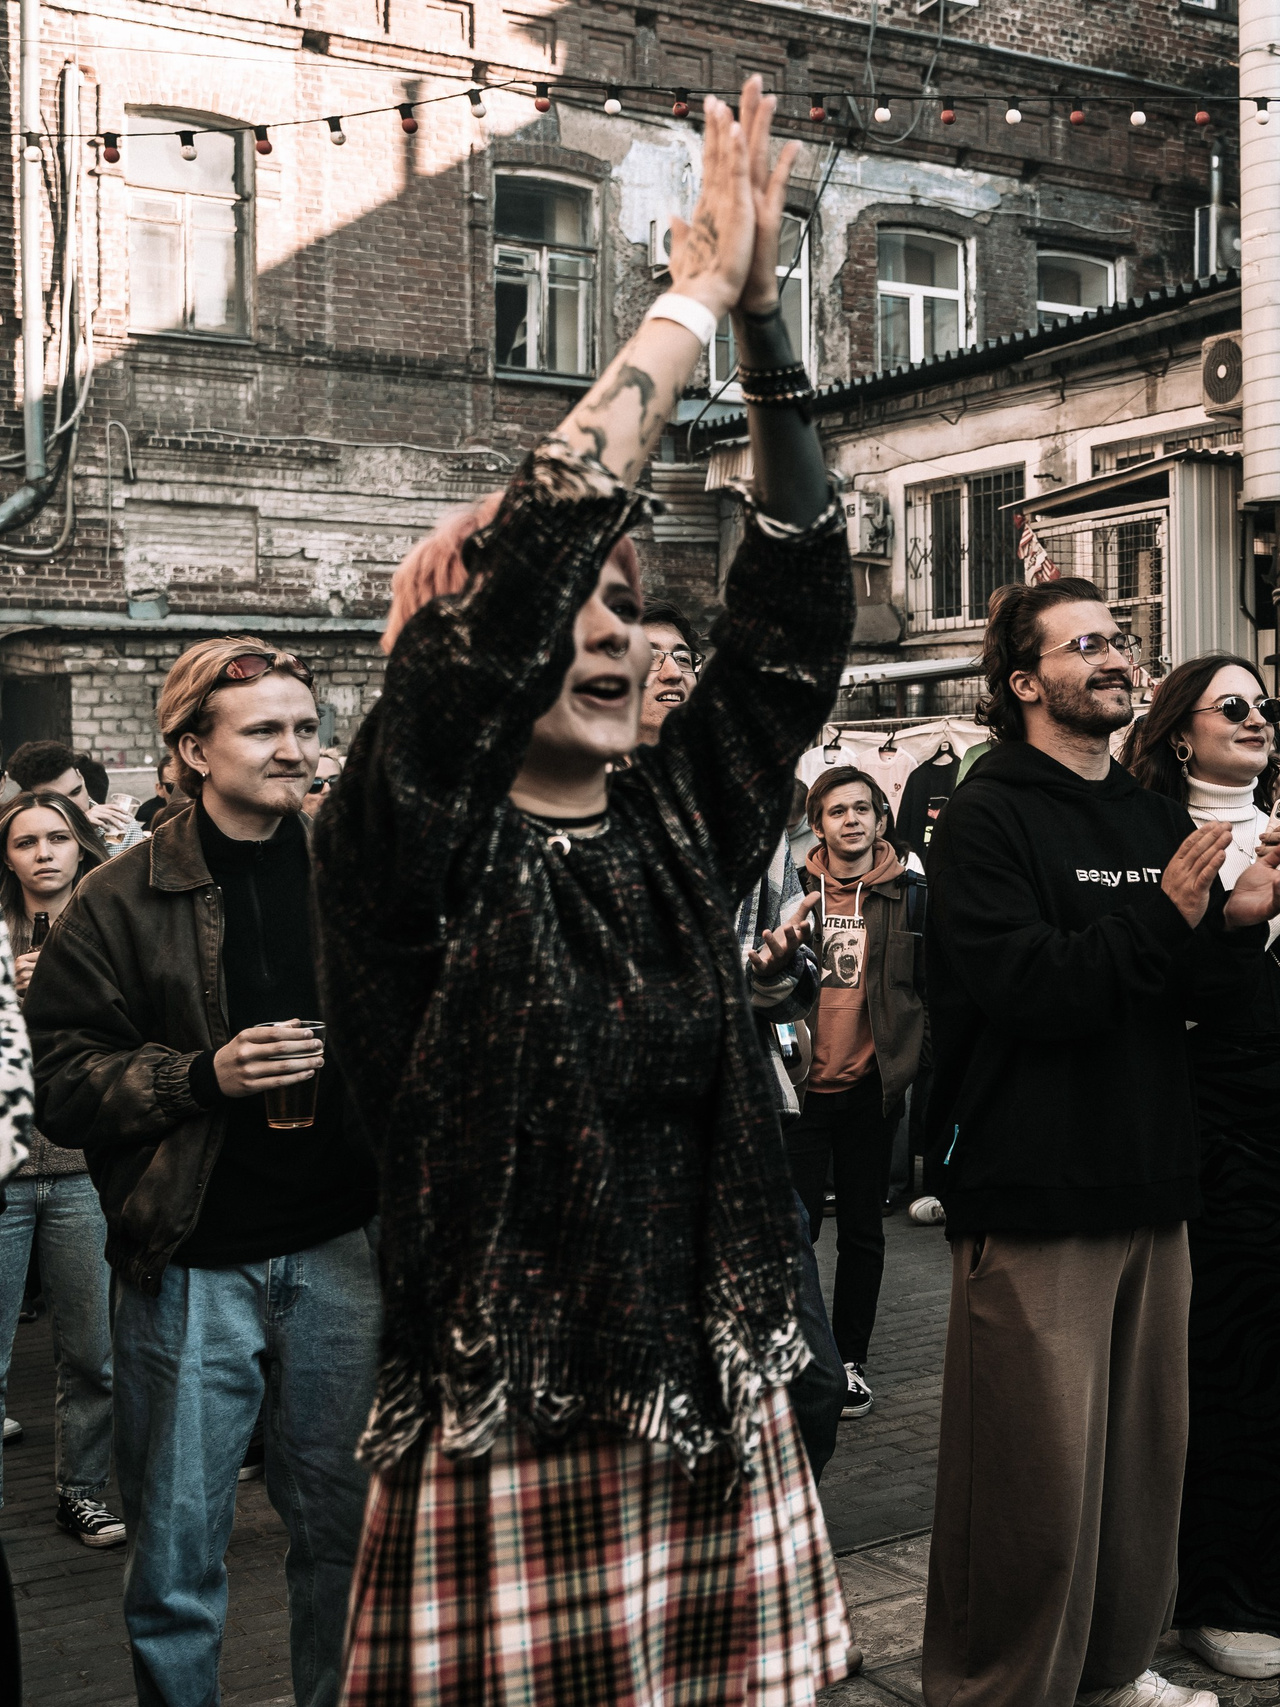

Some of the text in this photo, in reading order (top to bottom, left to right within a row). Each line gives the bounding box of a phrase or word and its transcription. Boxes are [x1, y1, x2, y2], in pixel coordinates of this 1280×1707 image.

[1075, 867, 1162, 887] веду в IT
